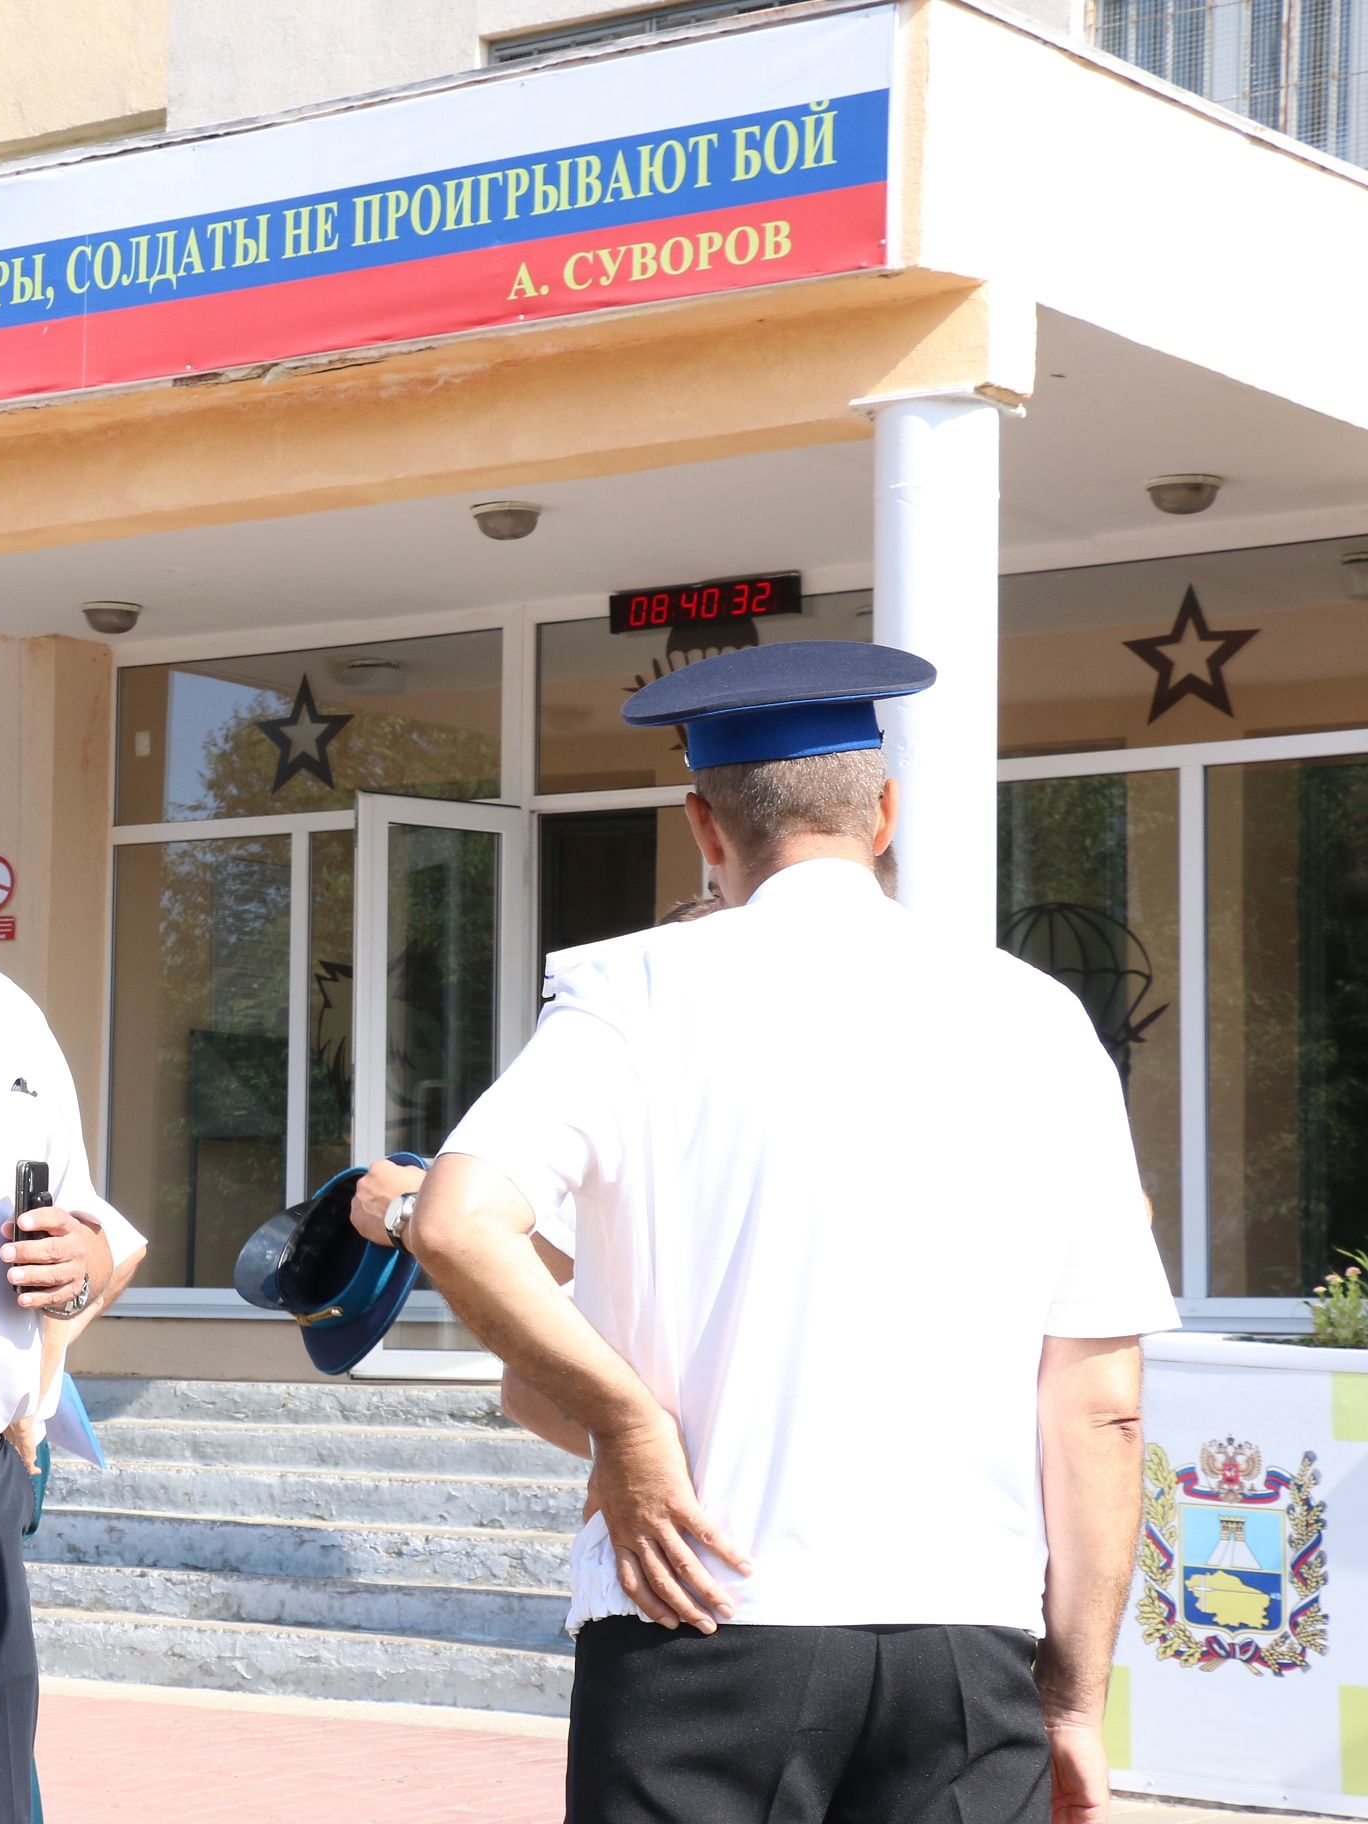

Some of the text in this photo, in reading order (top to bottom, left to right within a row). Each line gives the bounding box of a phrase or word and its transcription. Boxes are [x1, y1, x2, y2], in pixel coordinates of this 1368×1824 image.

[65, 214, 271, 295] СОЛДАТЫ
[282, 202, 339, 259] НЕ
[351, 133, 719, 248] ПРОИГРЫВАЮТ
[731, 98, 838, 183] БОЙ
[507, 220, 793, 302] А. СУВОРОВ
